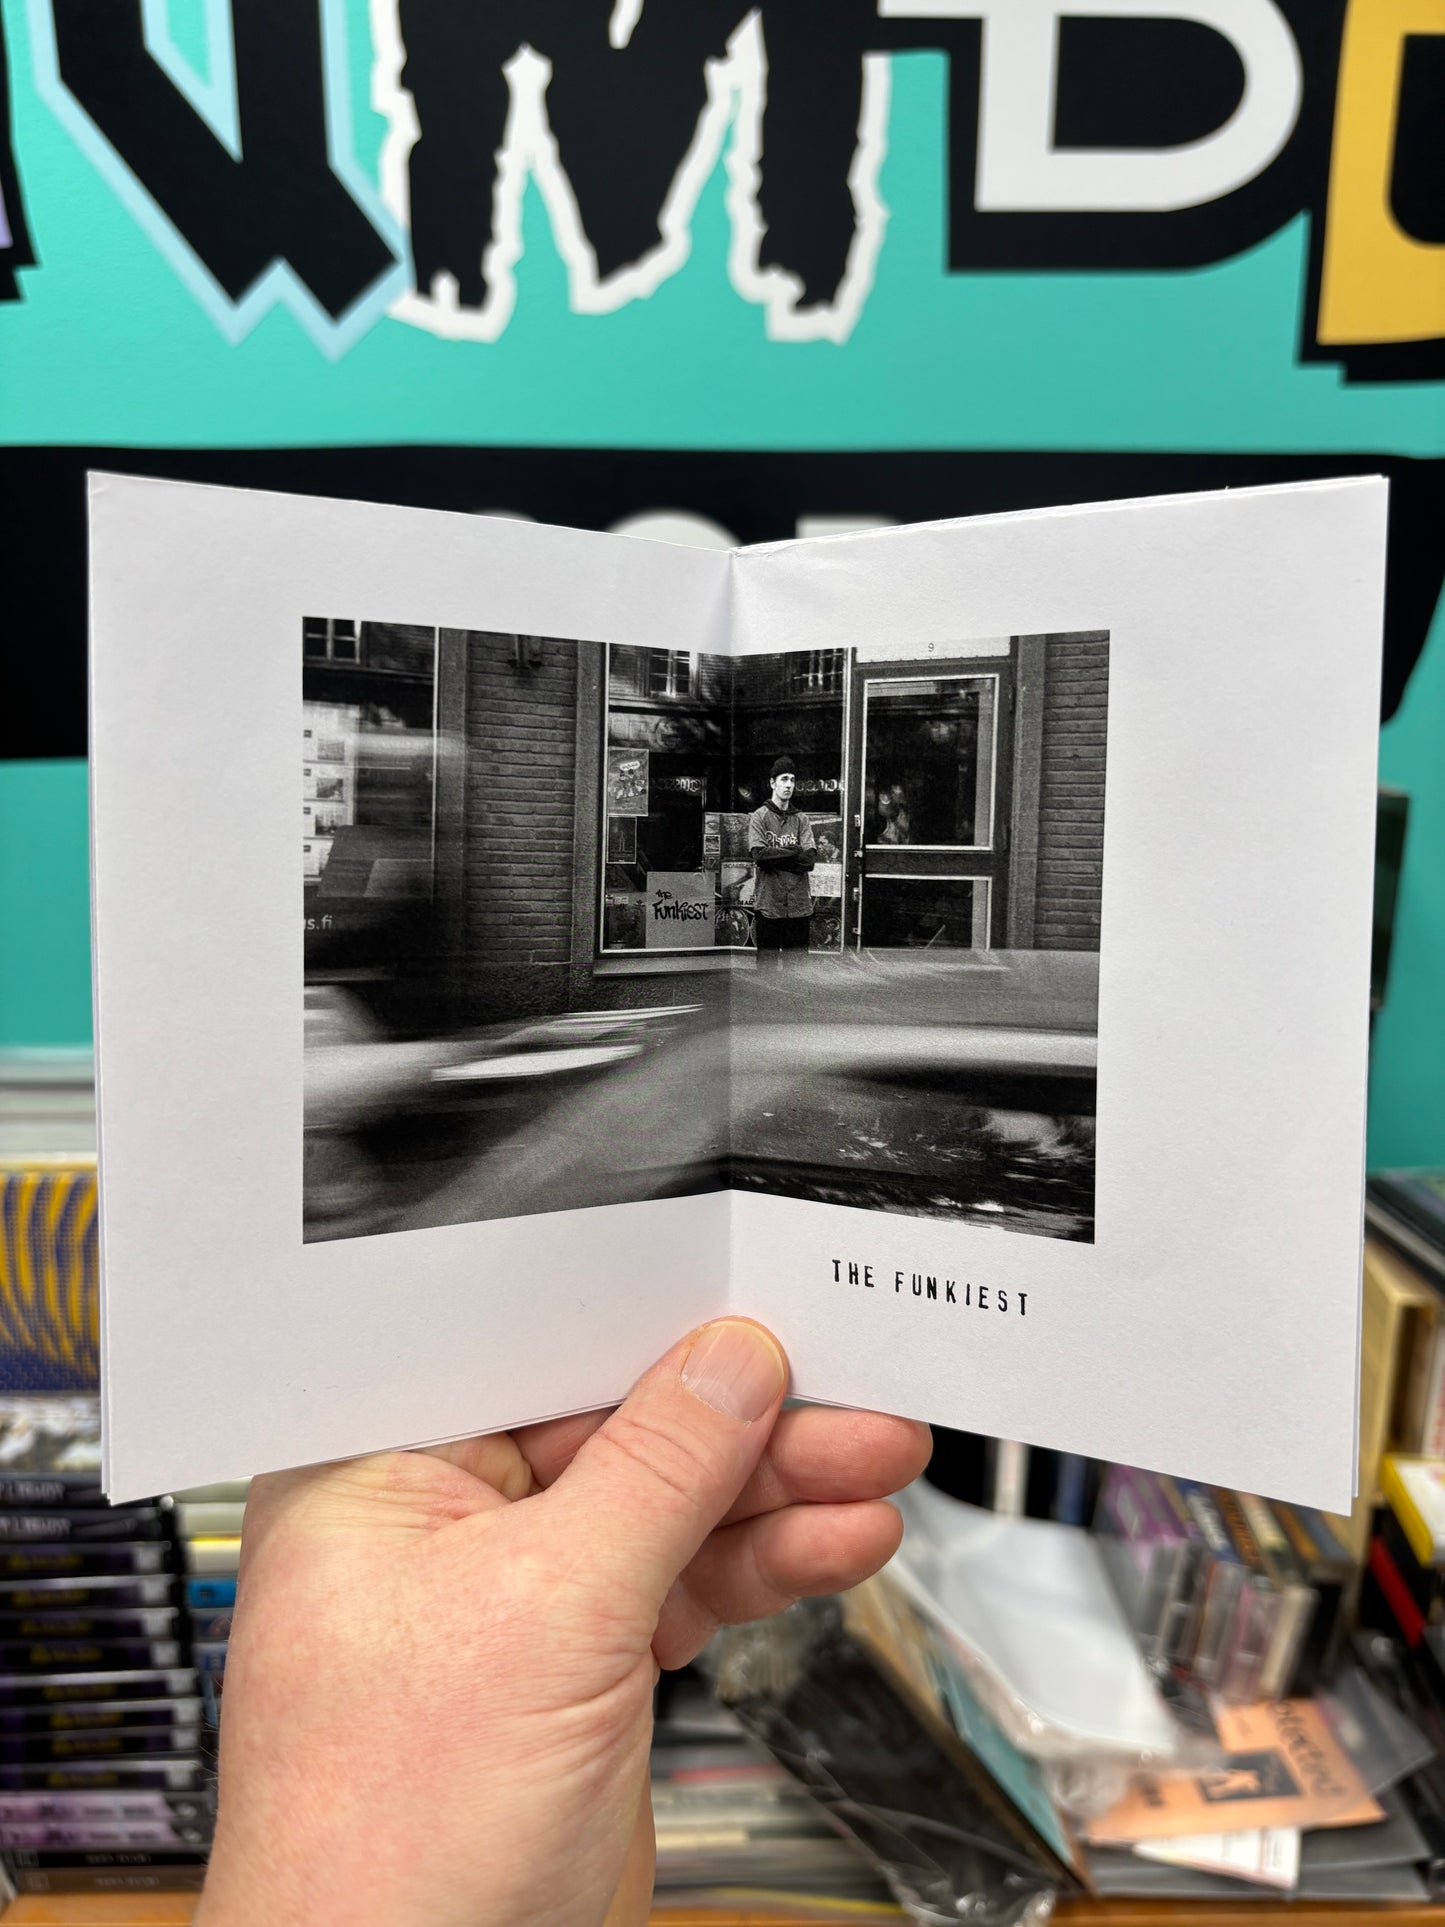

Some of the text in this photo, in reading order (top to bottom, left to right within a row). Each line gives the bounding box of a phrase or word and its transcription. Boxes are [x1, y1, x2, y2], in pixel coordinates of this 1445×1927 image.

[927, 642, 935, 653] 9
[832, 1259, 1028, 1316] THE FUNKIEST
